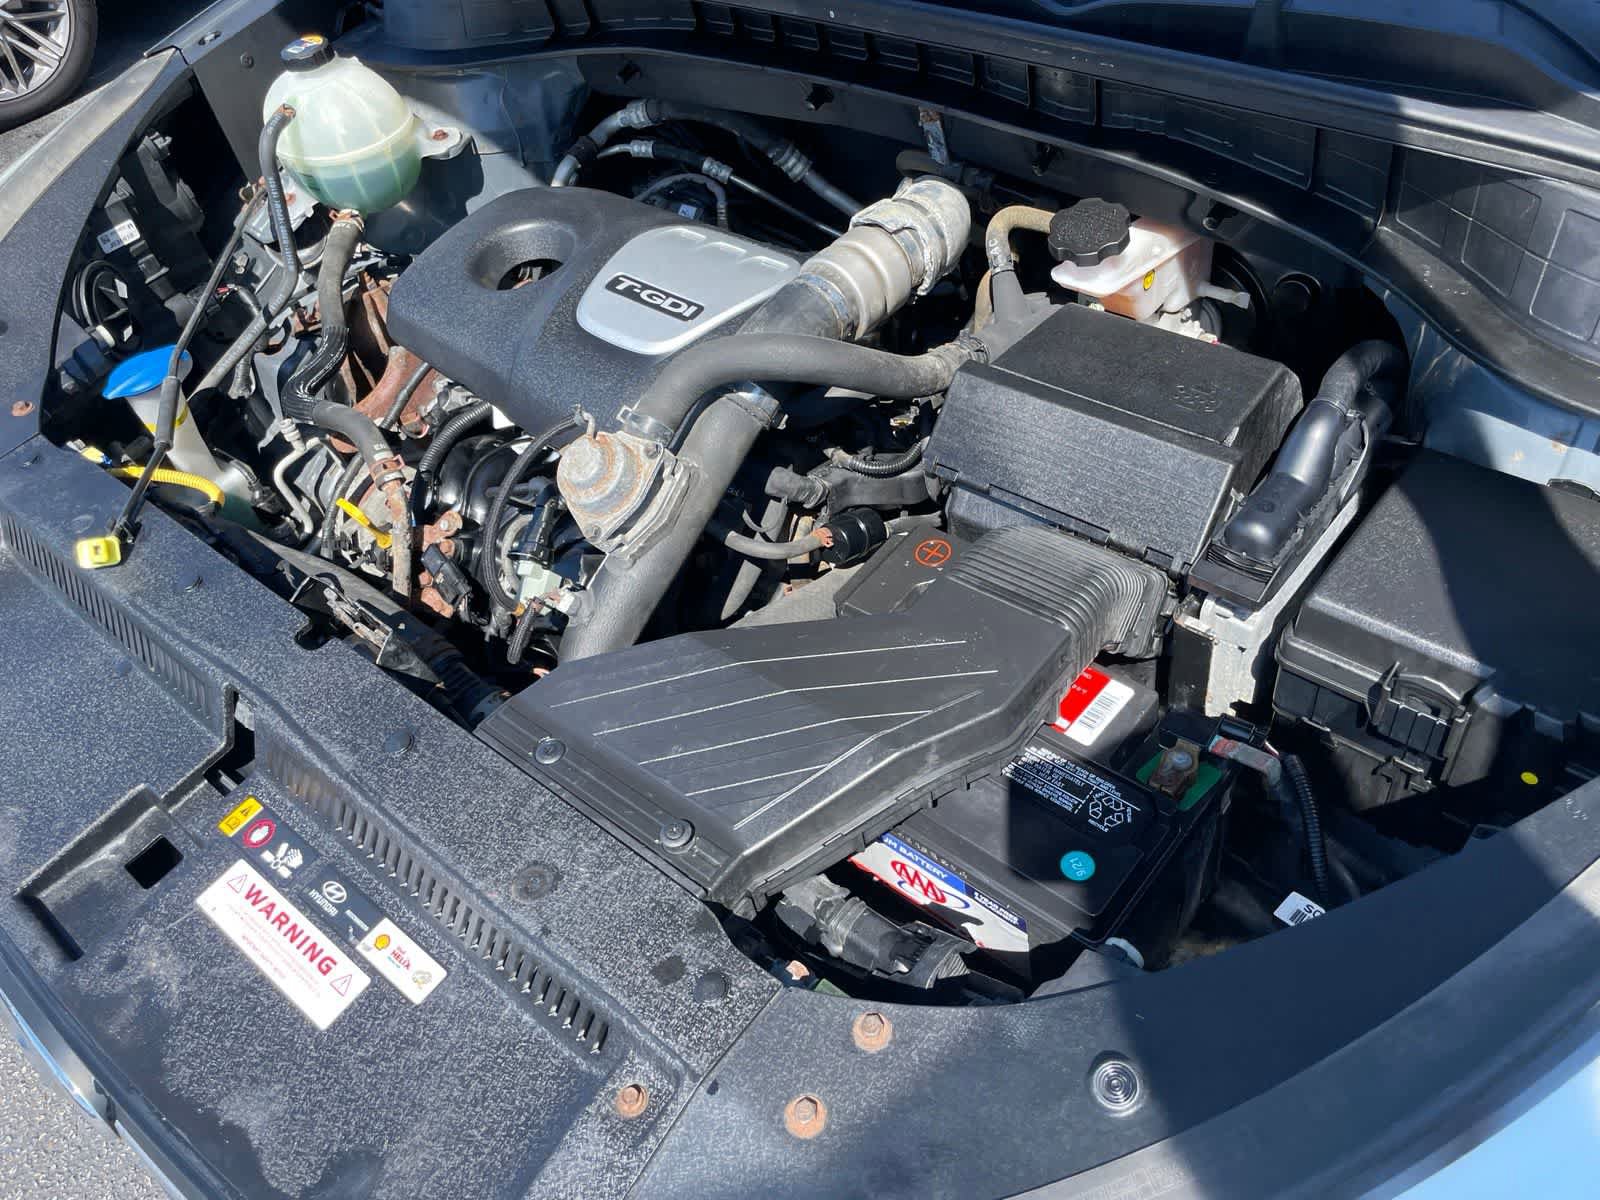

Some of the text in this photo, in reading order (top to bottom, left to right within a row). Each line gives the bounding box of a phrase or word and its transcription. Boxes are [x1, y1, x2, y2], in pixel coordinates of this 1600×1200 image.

[615, 276, 698, 318] T-GDI
[891, 859, 947, 904] AAA
[896, 845, 949, 880] BATTERY
[308, 888, 339, 917] HYUNDAI
[243, 883, 338, 977] WARNING
